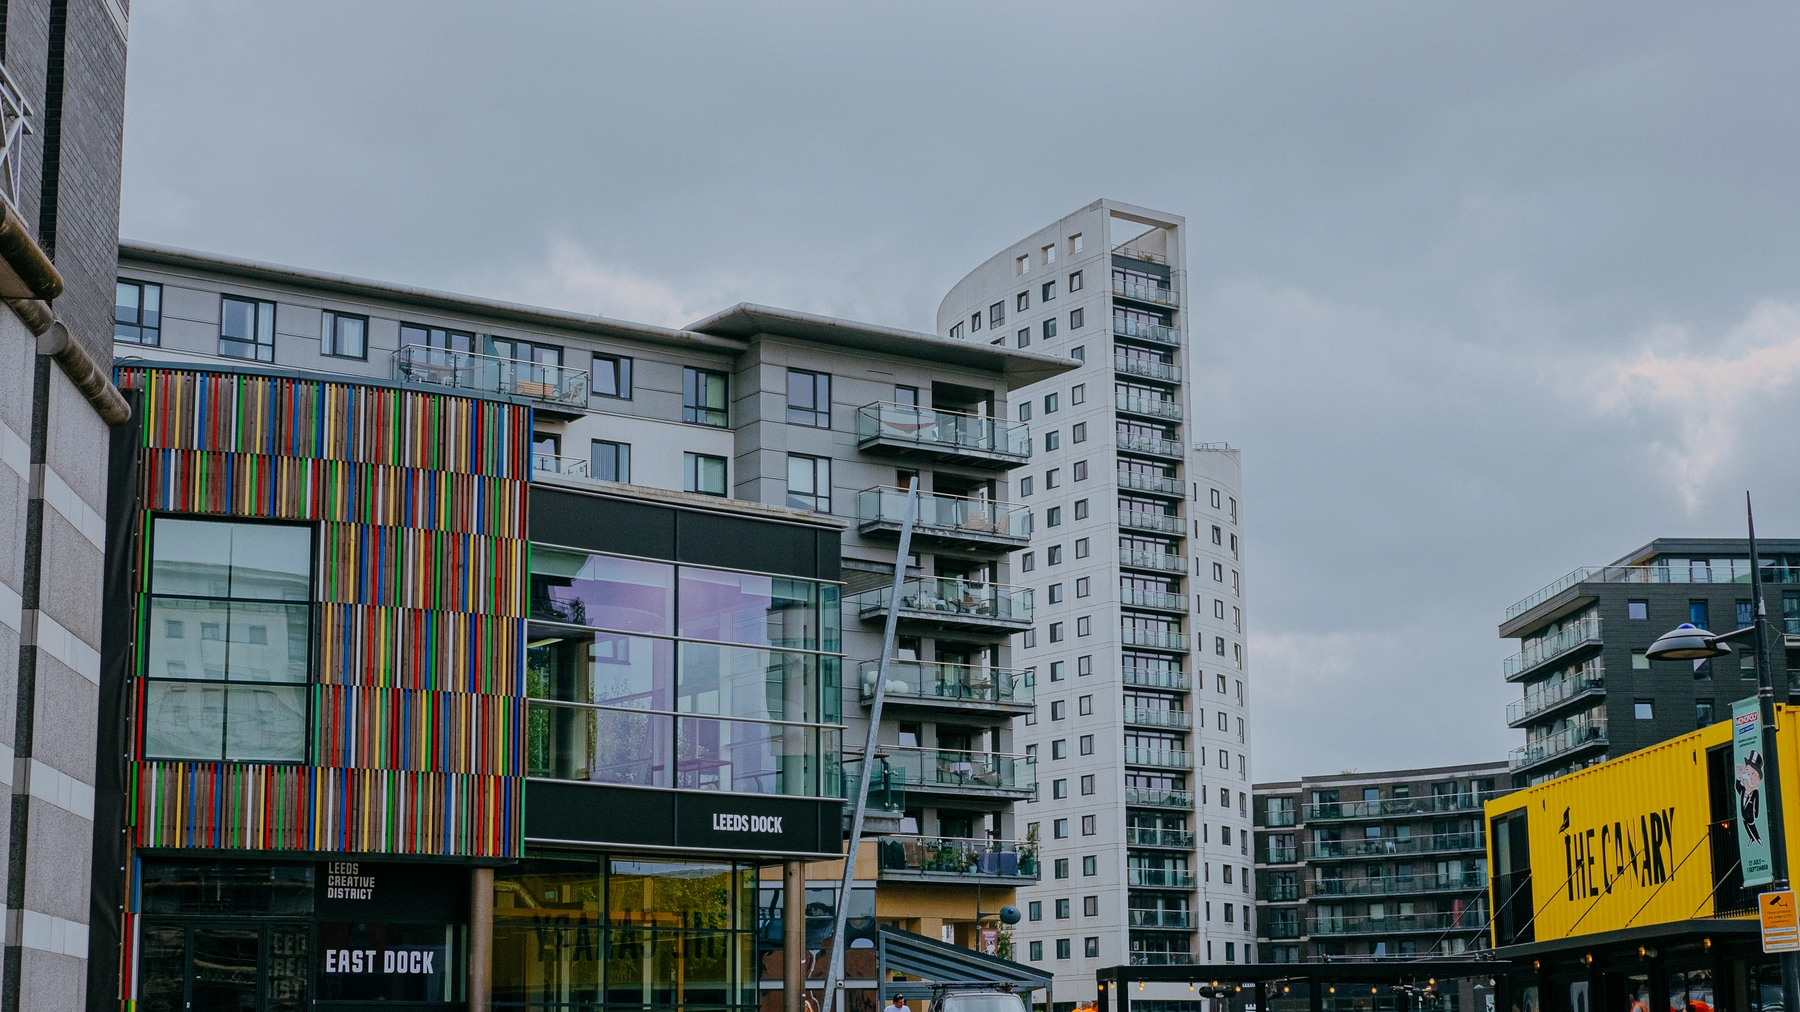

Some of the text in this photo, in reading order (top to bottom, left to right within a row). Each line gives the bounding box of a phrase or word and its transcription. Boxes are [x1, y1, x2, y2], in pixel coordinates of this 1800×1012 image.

[713, 813, 783, 834] LEEDS DOCK
[1564, 807, 1675, 902] THE CANARY
[328, 861, 359, 875] LEEDS
[328, 875, 375, 888] CREATIVE
[327, 887, 373, 900] DISTRICT
[326, 949, 434, 974] EAST DOCK
